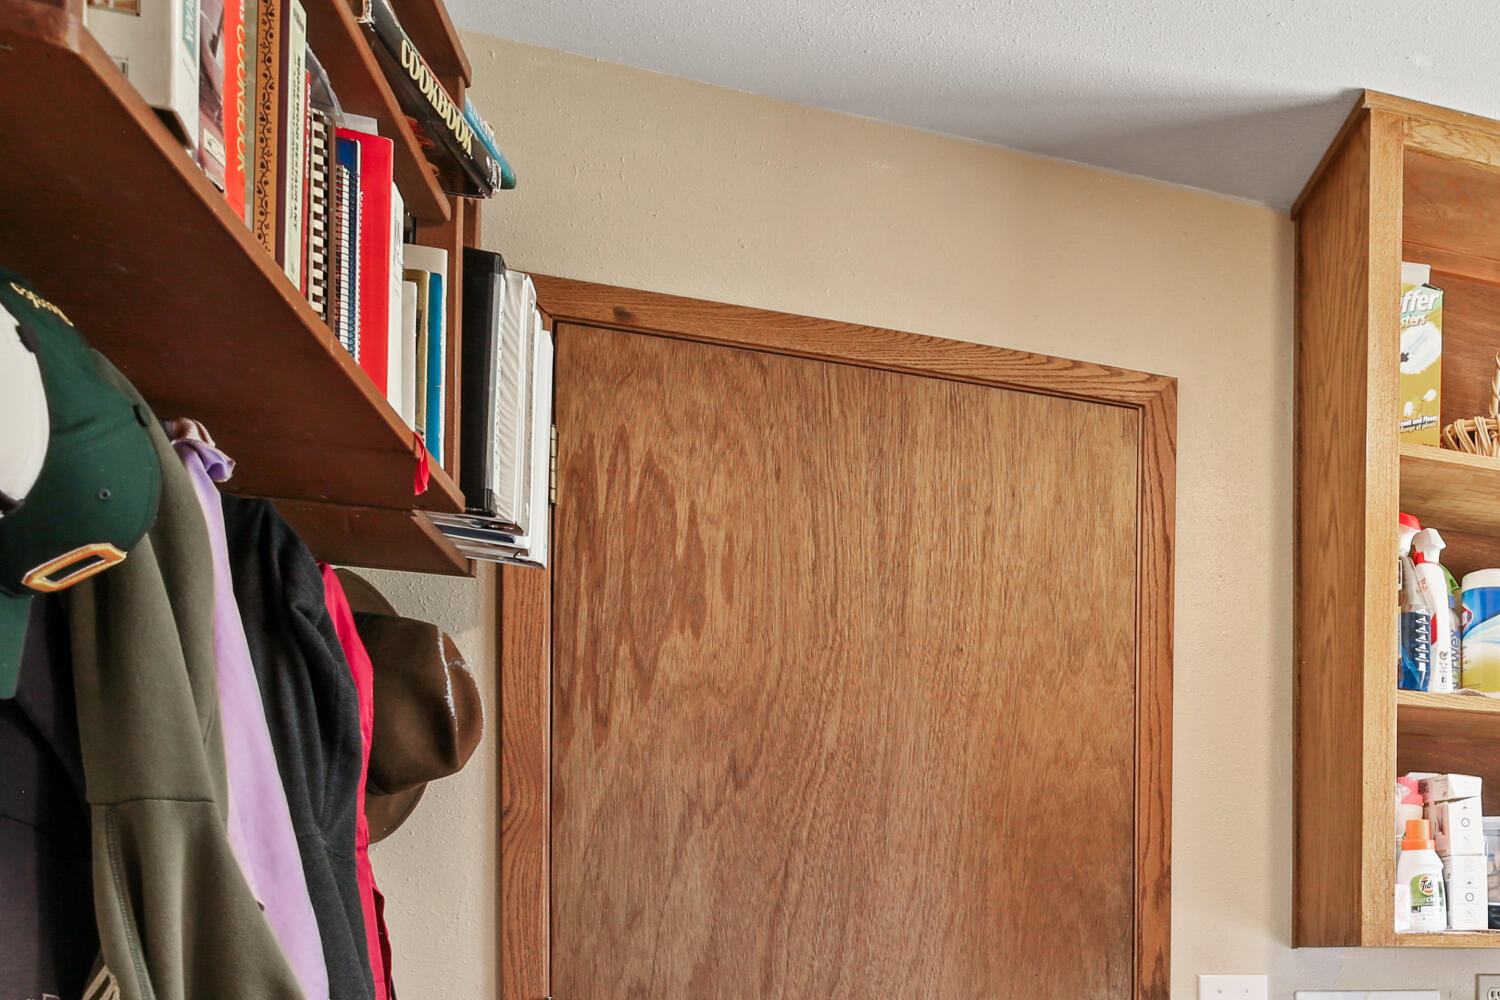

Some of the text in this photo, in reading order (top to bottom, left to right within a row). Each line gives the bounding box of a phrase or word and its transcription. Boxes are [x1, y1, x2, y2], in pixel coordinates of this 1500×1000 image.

[400, 39, 475, 157] COOKBOOK
[292, 143, 300, 231] RESTAURANT
[1400, 288, 1440, 314] ffer
[1400, 314, 1428, 328] sters
